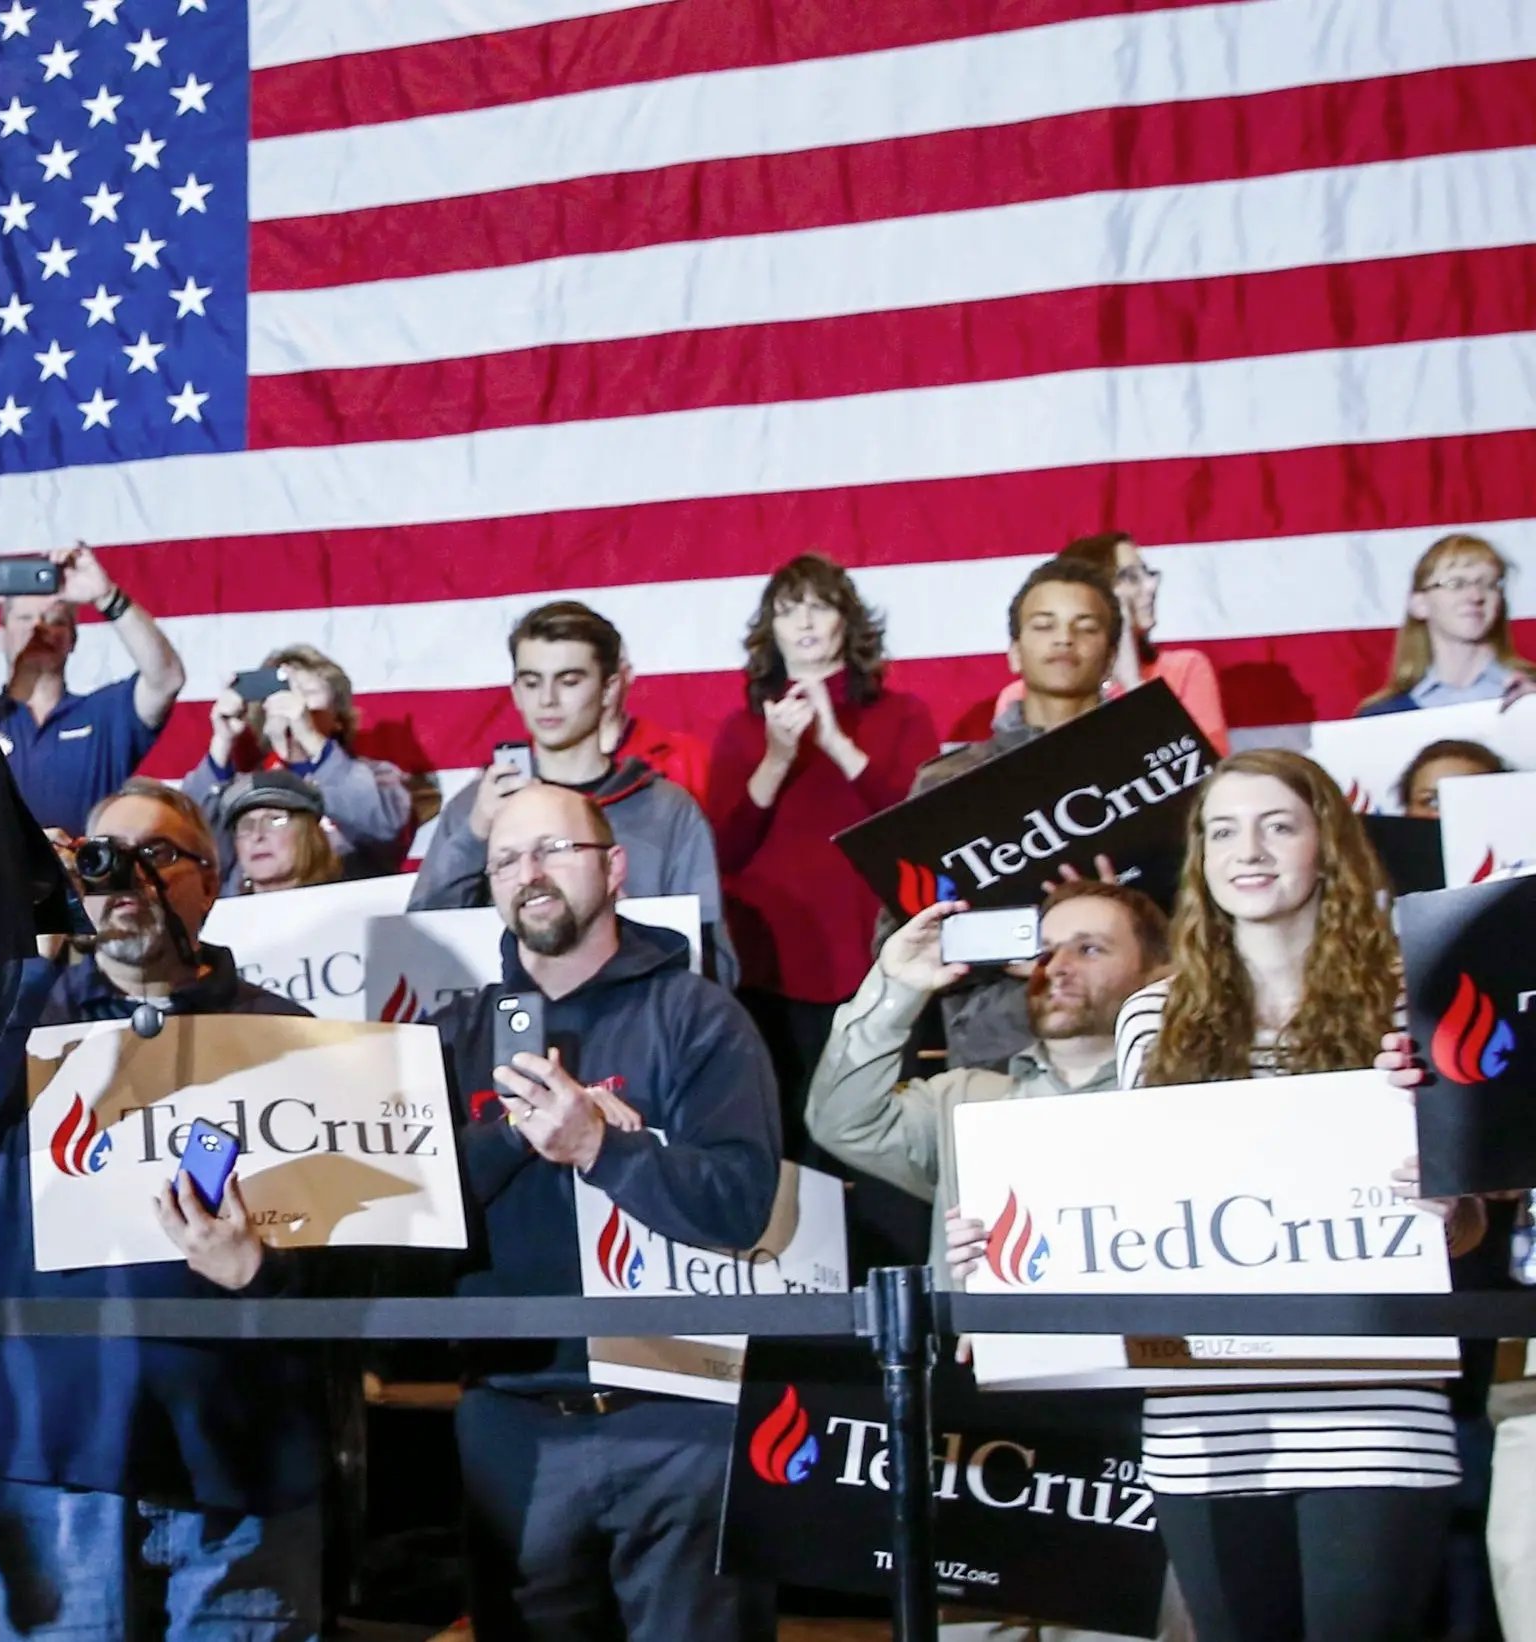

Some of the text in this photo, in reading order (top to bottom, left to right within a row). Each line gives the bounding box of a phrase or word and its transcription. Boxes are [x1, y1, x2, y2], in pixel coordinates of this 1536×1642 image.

[1144, 734, 1197, 768] 2016
[941, 750, 1213, 890] TedCruz
[380, 1101, 434, 1119] 2016
[1350, 1186, 1400, 1208] 201
[1058, 1195, 1423, 1274] TedCruz
[1101, 1458, 1145, 1484] 201
